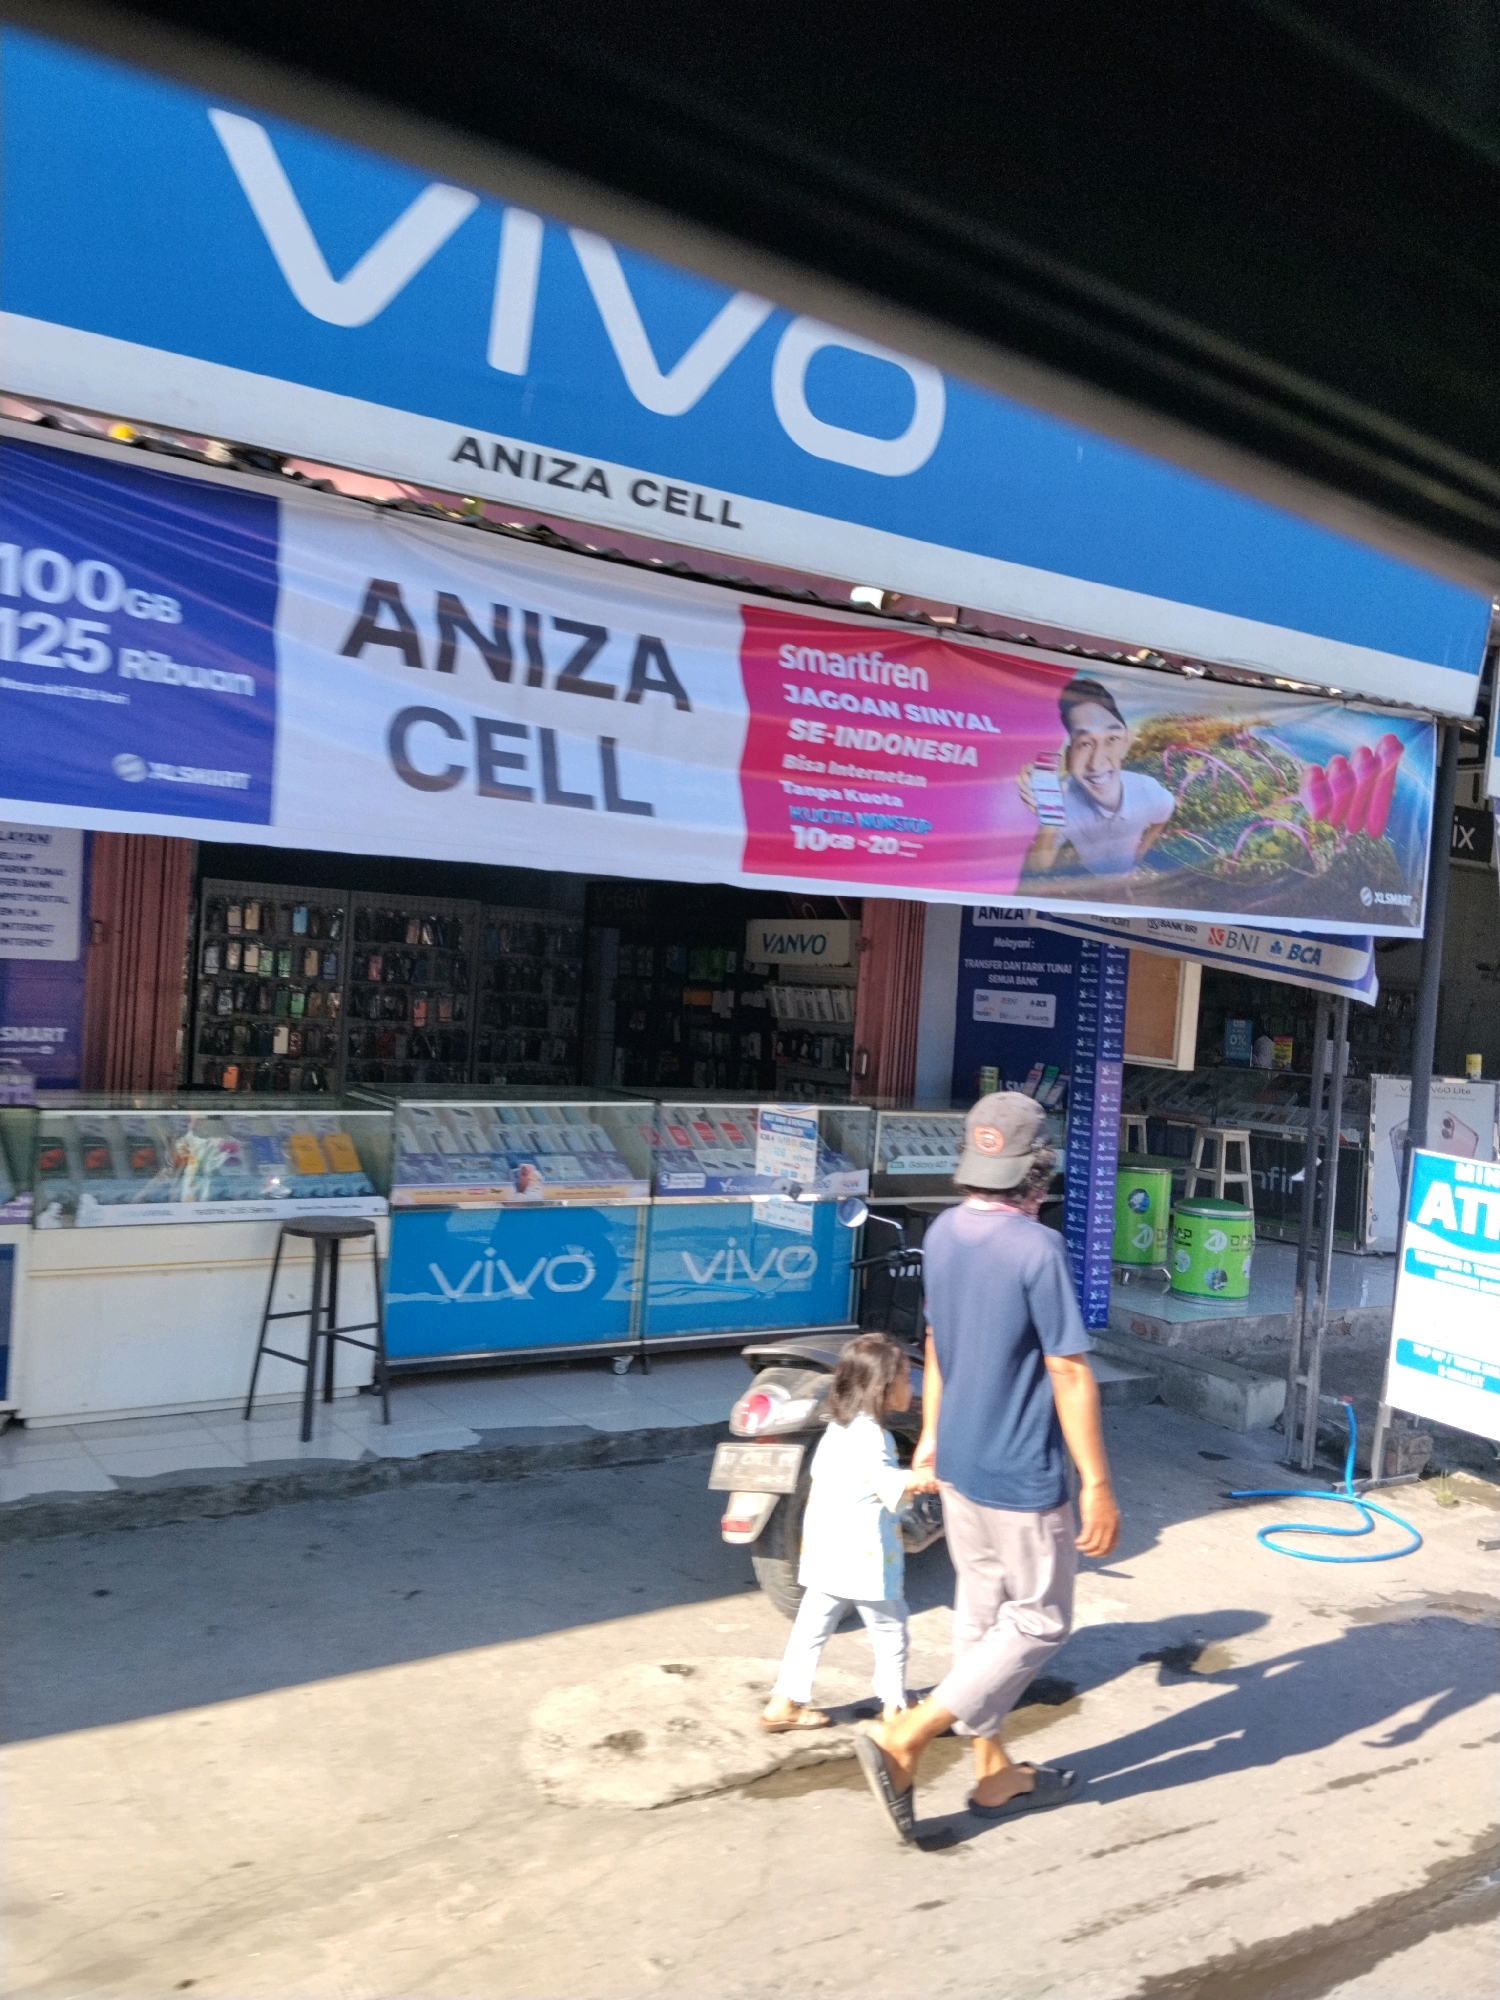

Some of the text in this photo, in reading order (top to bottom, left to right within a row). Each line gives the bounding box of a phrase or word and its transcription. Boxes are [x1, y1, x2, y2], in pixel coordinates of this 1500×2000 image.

[449, 436, 744, 529] ANIZA CELL
[0, 608, 113, 674] 125
[341, 579, 693, 711] ANIZA
[778, 644, 930, 692] smartfren
[782, 683, 1002, 734] JAGOAN SINYAL
[787, 718, 978, 768] SE-INDONESIA
[388, 705, 655, 817] CELL
[782, 754, 928, 788] Bisa Internetan
[779, 780, 904, 808] Tanpa Kuota
[789, 805, 933, 835] KUOTA NONSTOP
[790, 824, 855, 851] 10GB
[978, 906, 1025, 920] ANIZA
[1374, 891, 1413, 907] XLSMART
[762, 932, 827, 955] VANVO
[1160, 919, 1184, 932] BANK
[1225, 930, 1260, 954] BNI
[1287, 942, 1322, 966] BCA
[964, 958, 1072, 974] TRANSFER DAN TARIK TUNAI
[988, 974, 1039, 986] SEMUA BANK
[1229, 1034, 1247, 1046] 0%
[1431, 1085, 1451, 1094] V60
[1453, 1087, 1471, 1095] Lite
[429, 1247, 597, 1299] vivo
[682, 1237, 819, 1283] vivo
